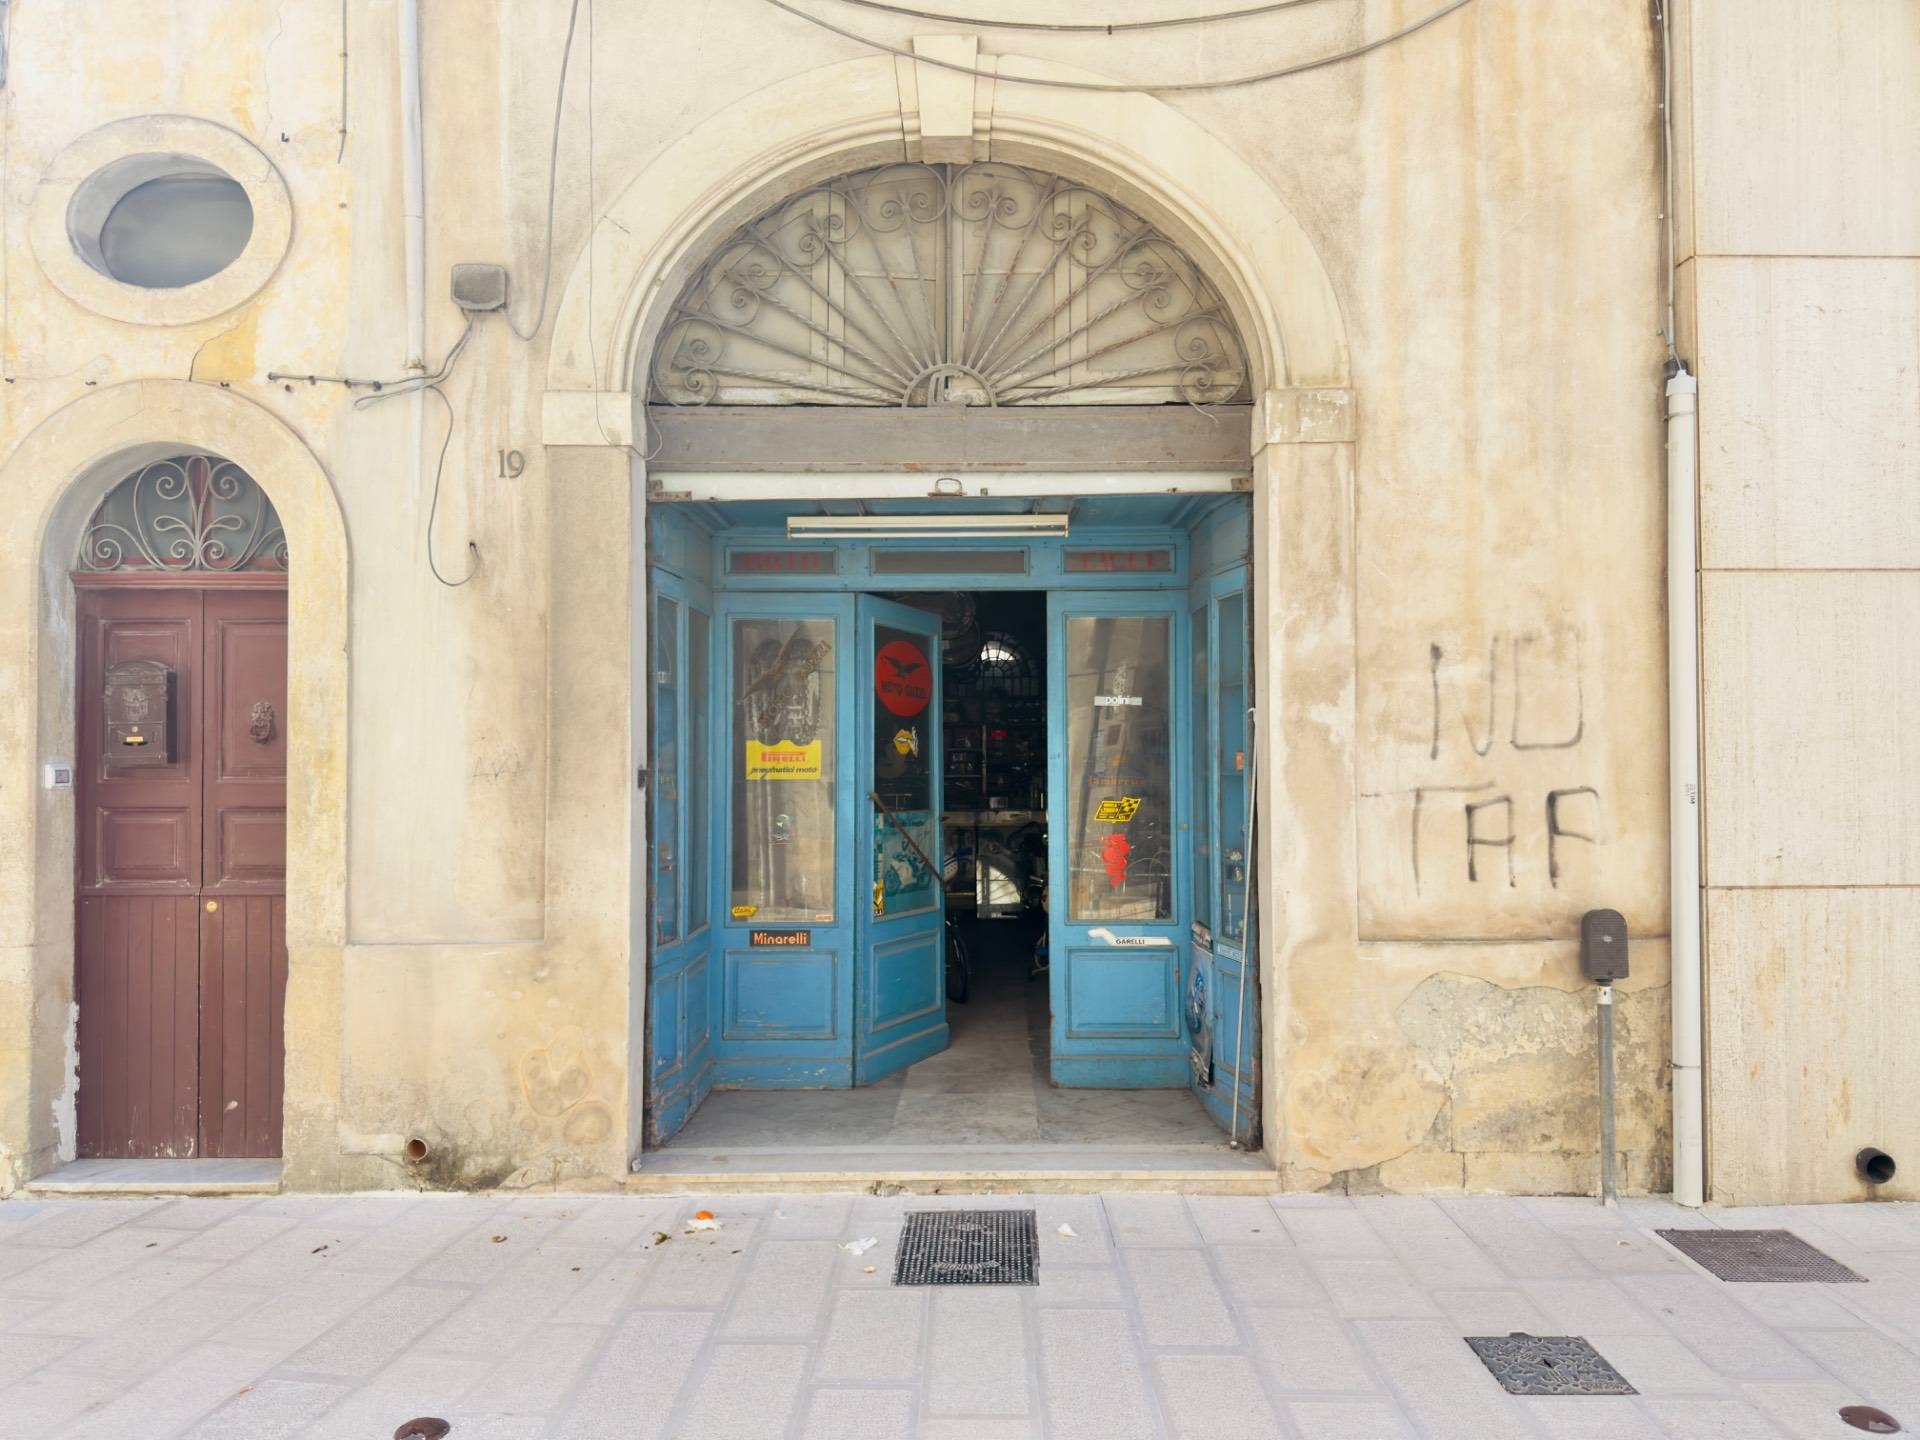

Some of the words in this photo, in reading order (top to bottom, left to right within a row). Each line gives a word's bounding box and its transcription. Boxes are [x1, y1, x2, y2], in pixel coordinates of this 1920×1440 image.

[498, 449, 525, 479] 19
[761, 751, 806, 763] PIRELLI
[753, 932, 808, 945] Minarelli
